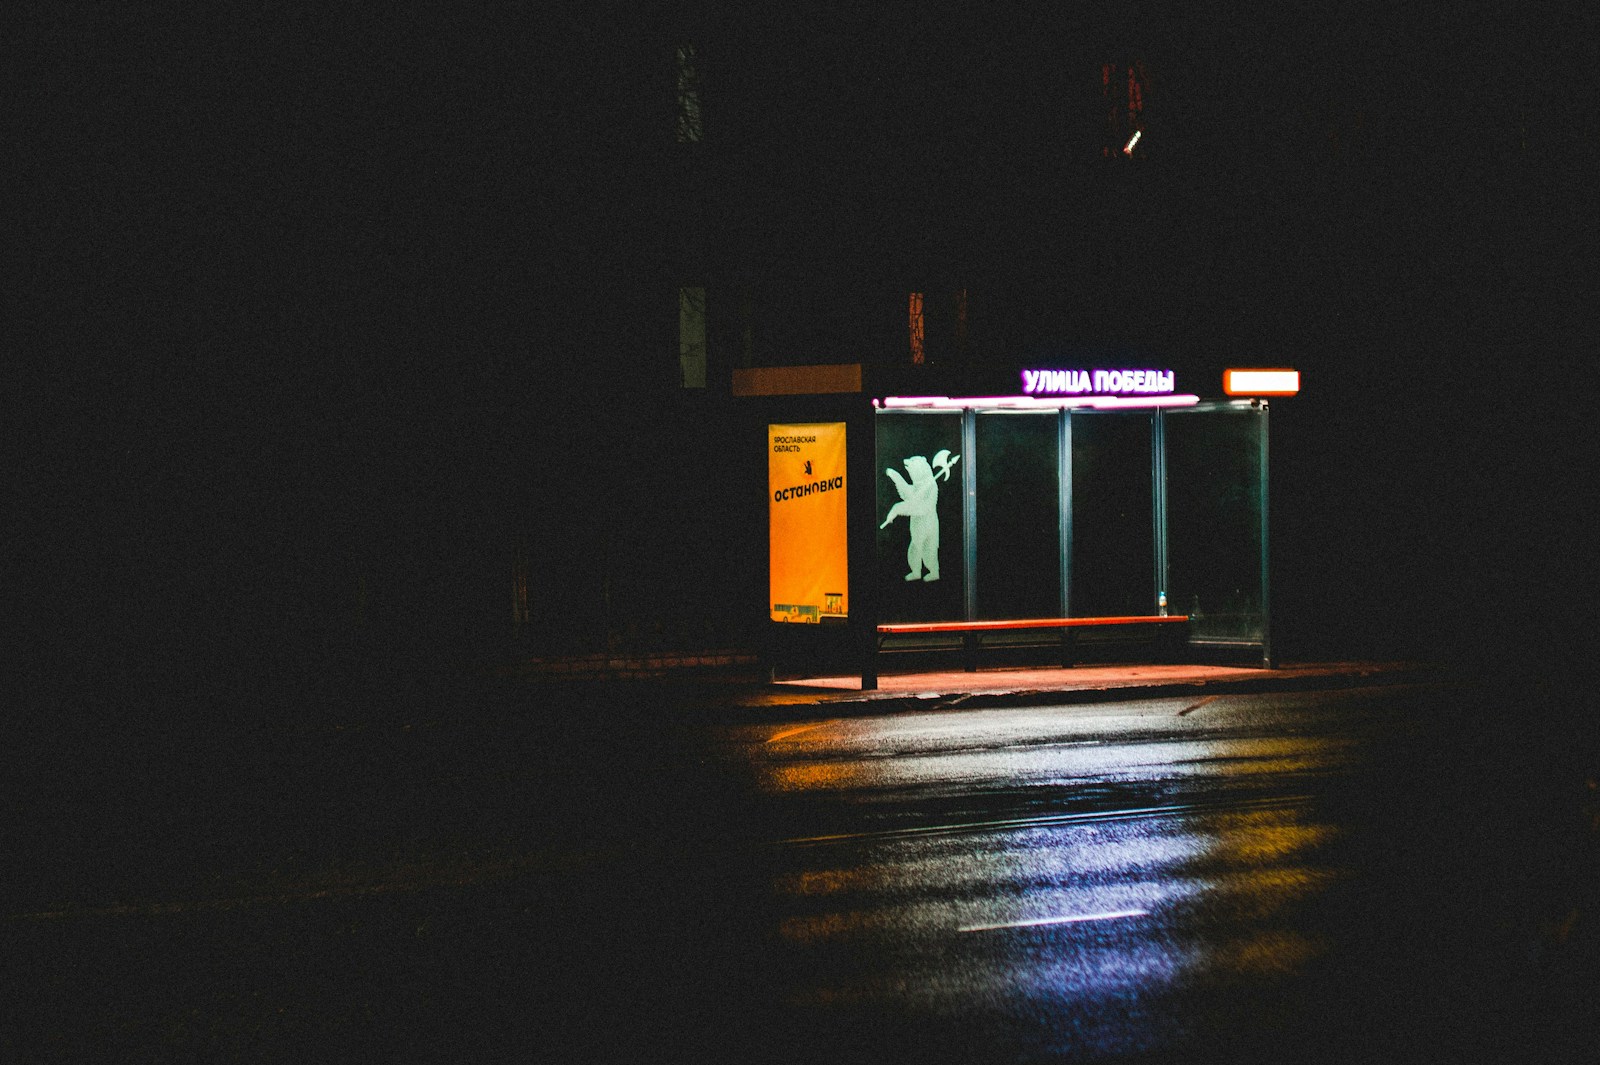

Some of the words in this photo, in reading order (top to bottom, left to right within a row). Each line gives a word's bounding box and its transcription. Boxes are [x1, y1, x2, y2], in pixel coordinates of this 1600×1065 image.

[1023, 370, 1093, 392] УЛИЦА
[1095, 370, 1175, 392] ПОБЕДЫ
[773, 436, 816, 444] ЯРОСЛАВСКАЯ
[773, 445, 801, 453] ОБЛАСТЬ
